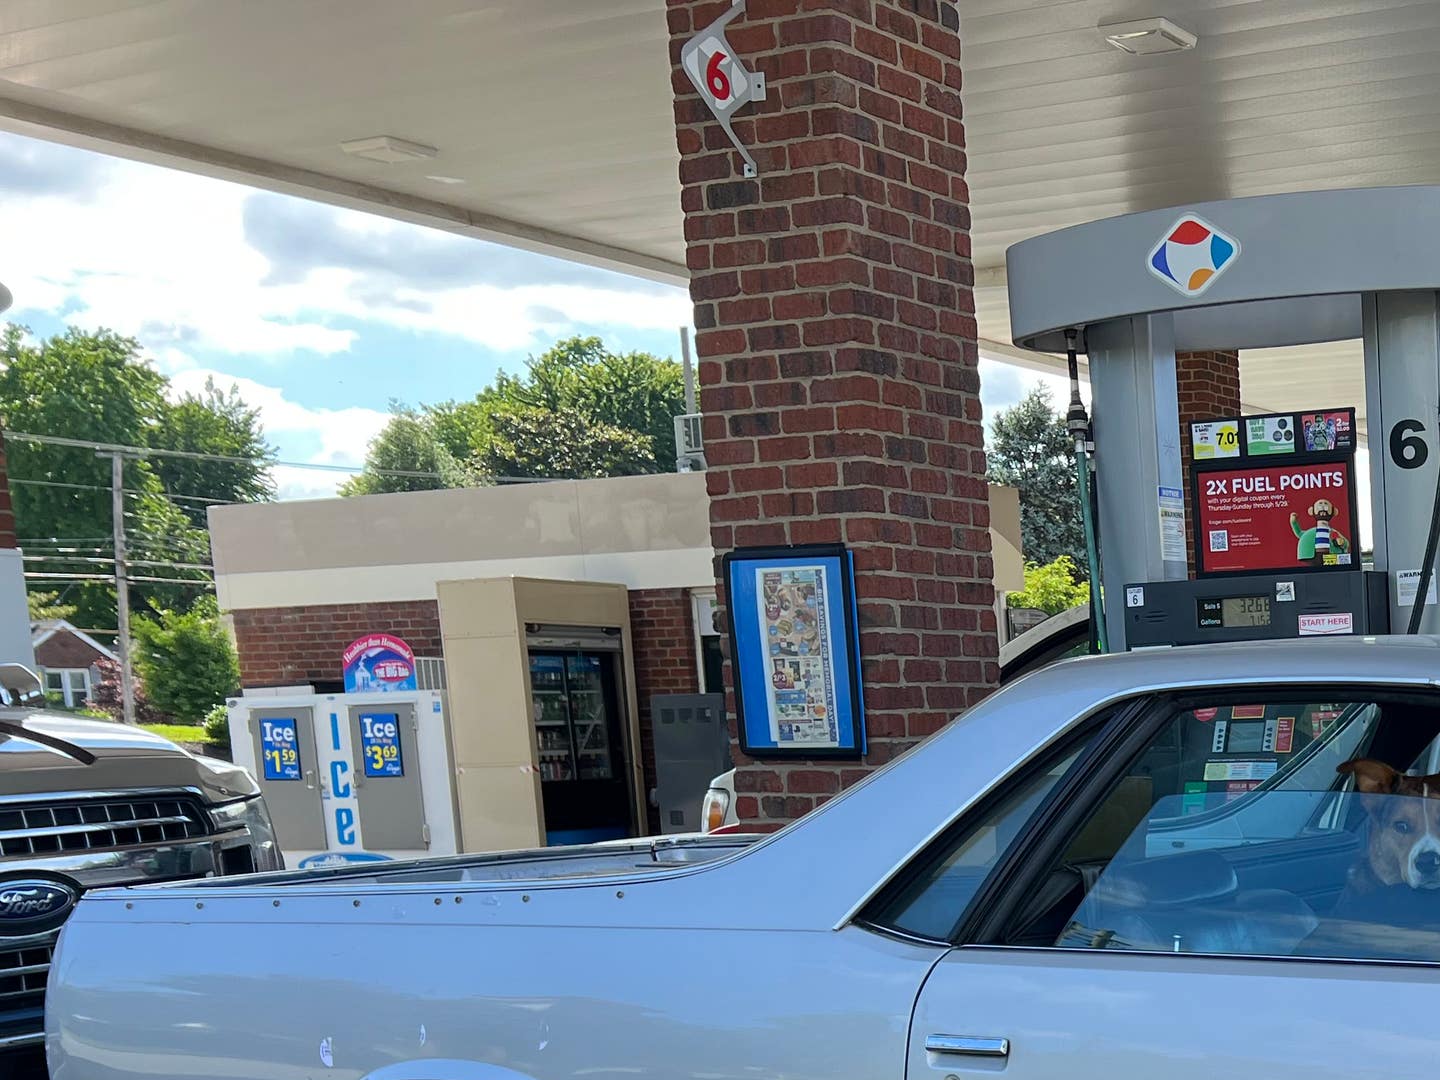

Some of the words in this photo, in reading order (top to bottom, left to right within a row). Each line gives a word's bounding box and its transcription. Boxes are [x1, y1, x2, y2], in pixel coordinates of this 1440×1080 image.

[706, 50, 731, 101] 6
[1389, 418, 1429, 470] 6
[1206, 479, 1227, 496] 2X
[1232, 476, 1276, 494] FUEL
[1280, 471, 1344, 491] POINTS
[1220, 497, 1232, 505] your
[1249, 494, 1269, 503] coupon
[1270, 493, 1286, 502] every
[1132, 594, 1139, 605] 6
[1301, 618, 1327, 627] START
[1328, 617, 1350, 626] HERE
[263, 722, 294, 742] Ice
[363, 717, 396, 738] Ice
[0, 888, 53, 914] Ford
